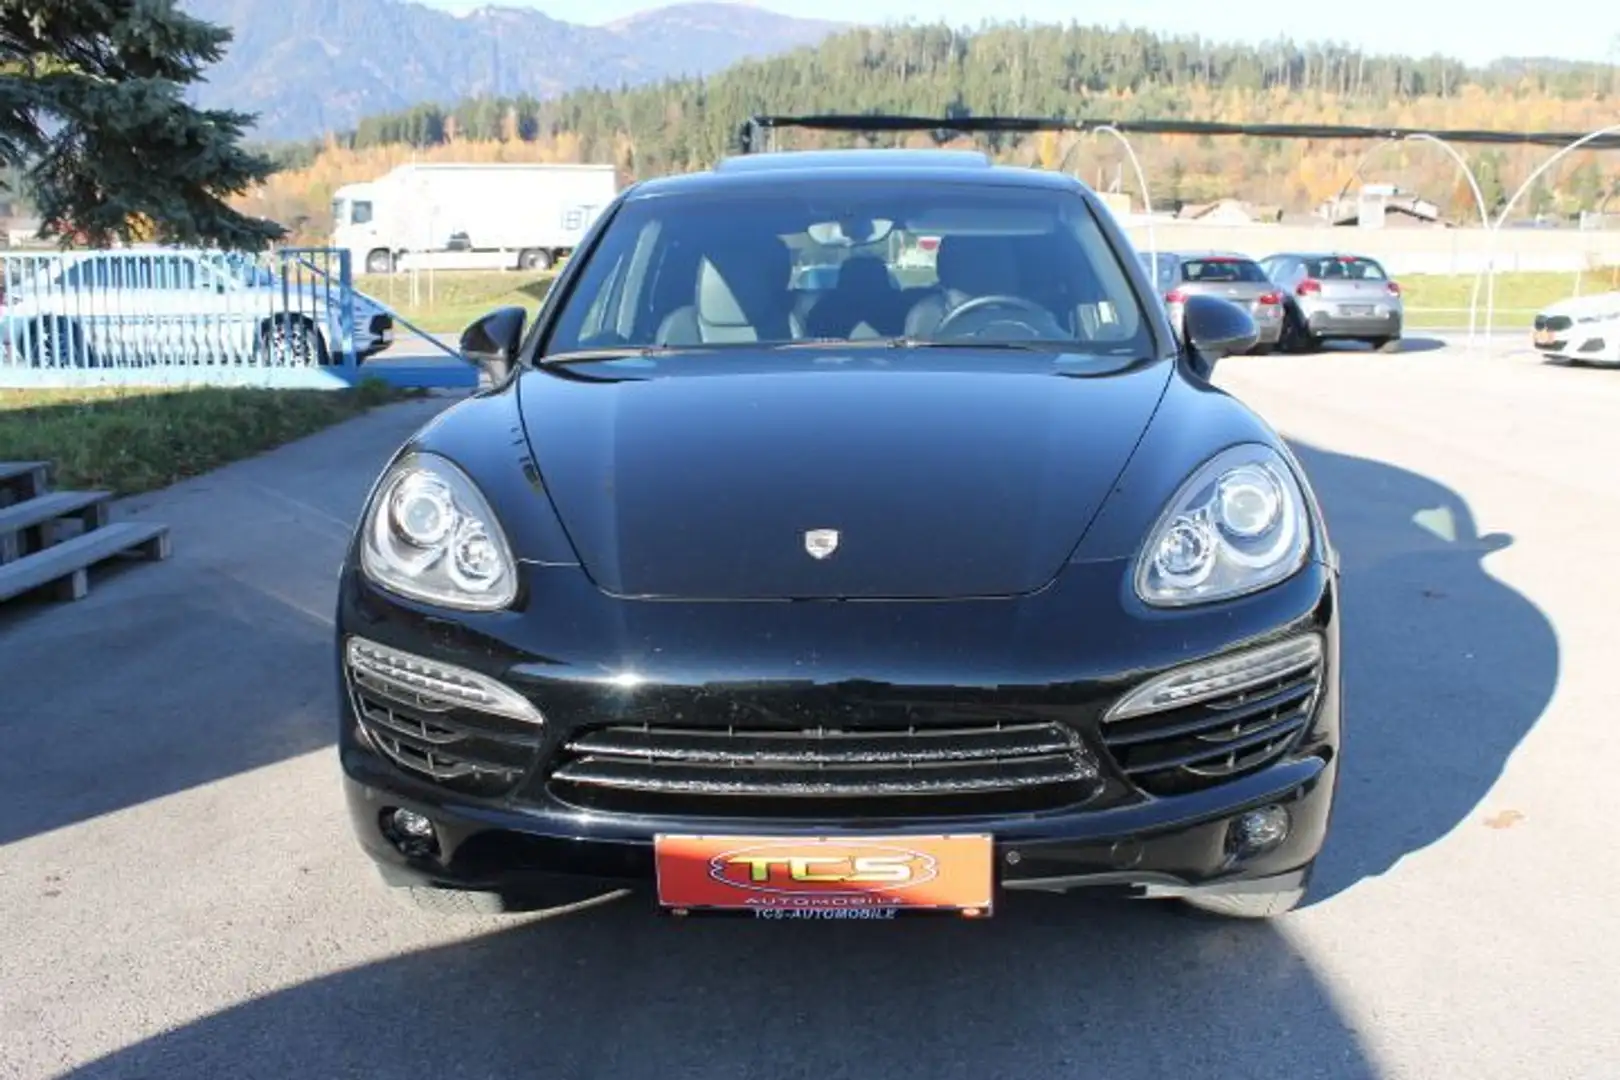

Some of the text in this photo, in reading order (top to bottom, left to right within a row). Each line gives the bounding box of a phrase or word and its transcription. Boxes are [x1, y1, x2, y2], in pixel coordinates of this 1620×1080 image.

[727, 855, 917, 881] TCS
[744, 896, 904, 906] AUTOMOBILE
[753, 907, 901, 919] TCS-AUTOMOBILE
